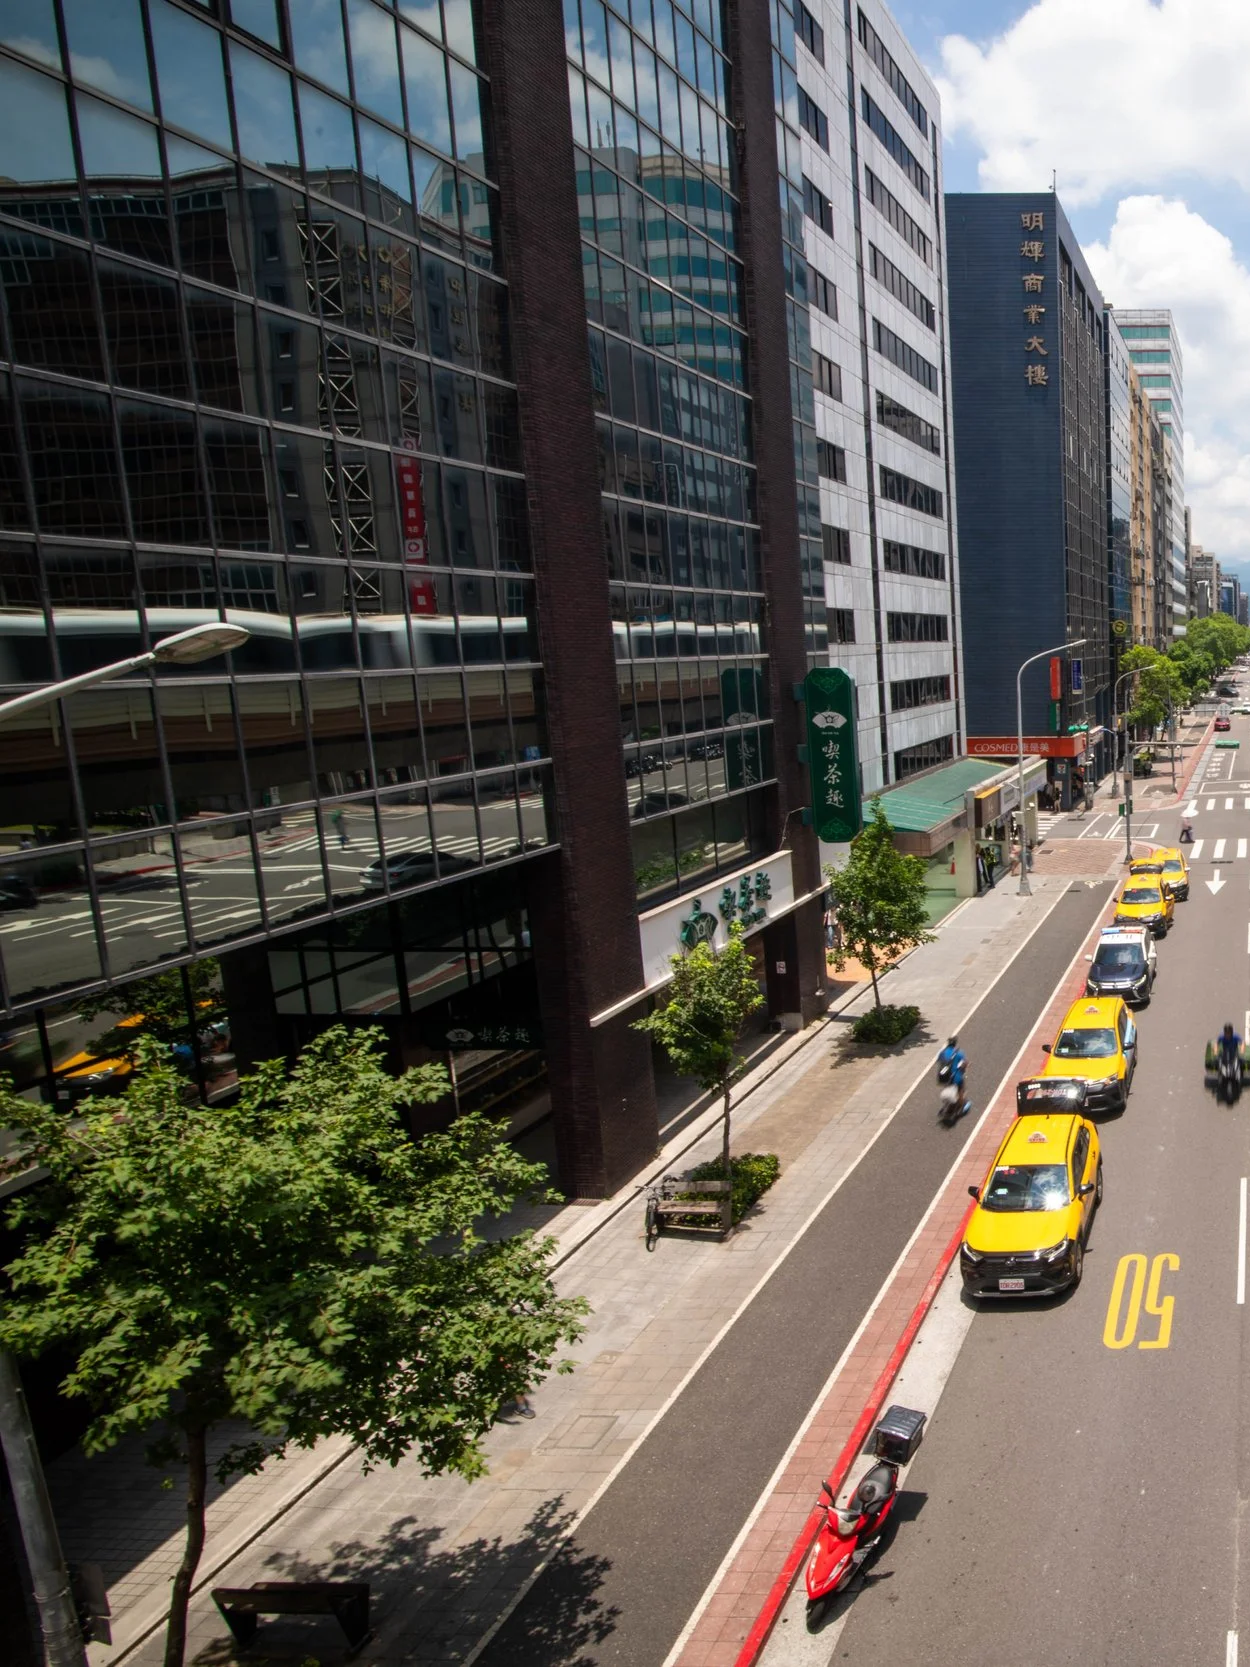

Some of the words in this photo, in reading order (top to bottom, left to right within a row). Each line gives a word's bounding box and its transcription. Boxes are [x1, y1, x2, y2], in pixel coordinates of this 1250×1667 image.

[1020, 212, 1048, 386] 明輝商業大樓
[822, 740, 844, 808] 喫茶趣
[974, 743, 1018, 753] COSMED
[1103, 1253, 1180, 1349] 50
